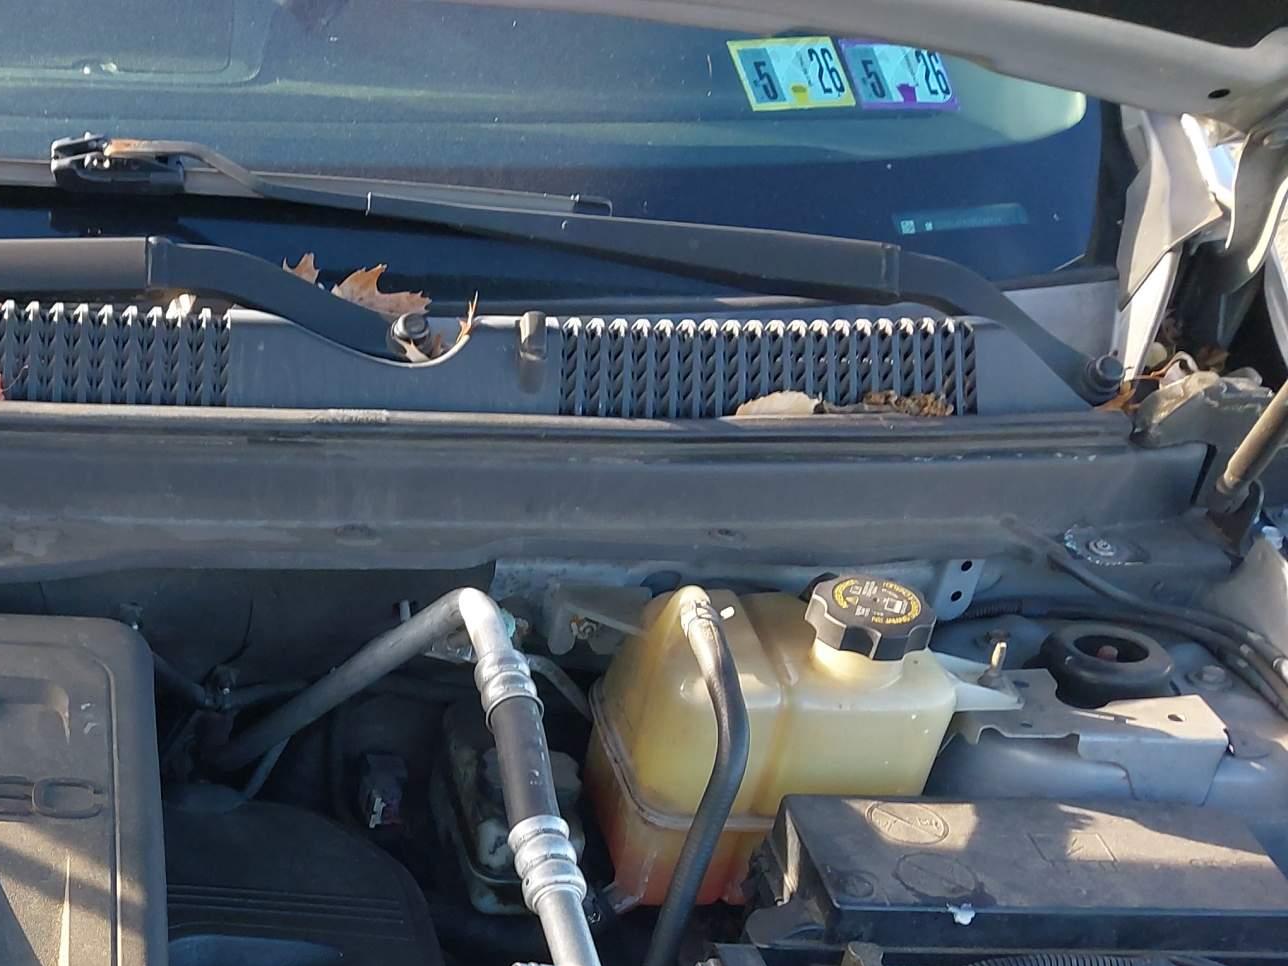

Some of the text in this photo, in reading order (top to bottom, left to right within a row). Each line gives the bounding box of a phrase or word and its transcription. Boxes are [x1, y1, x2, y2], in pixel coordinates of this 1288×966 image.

[753, 47, 844, 100] 5 26
[862, 48, 949, 99] 5 26
